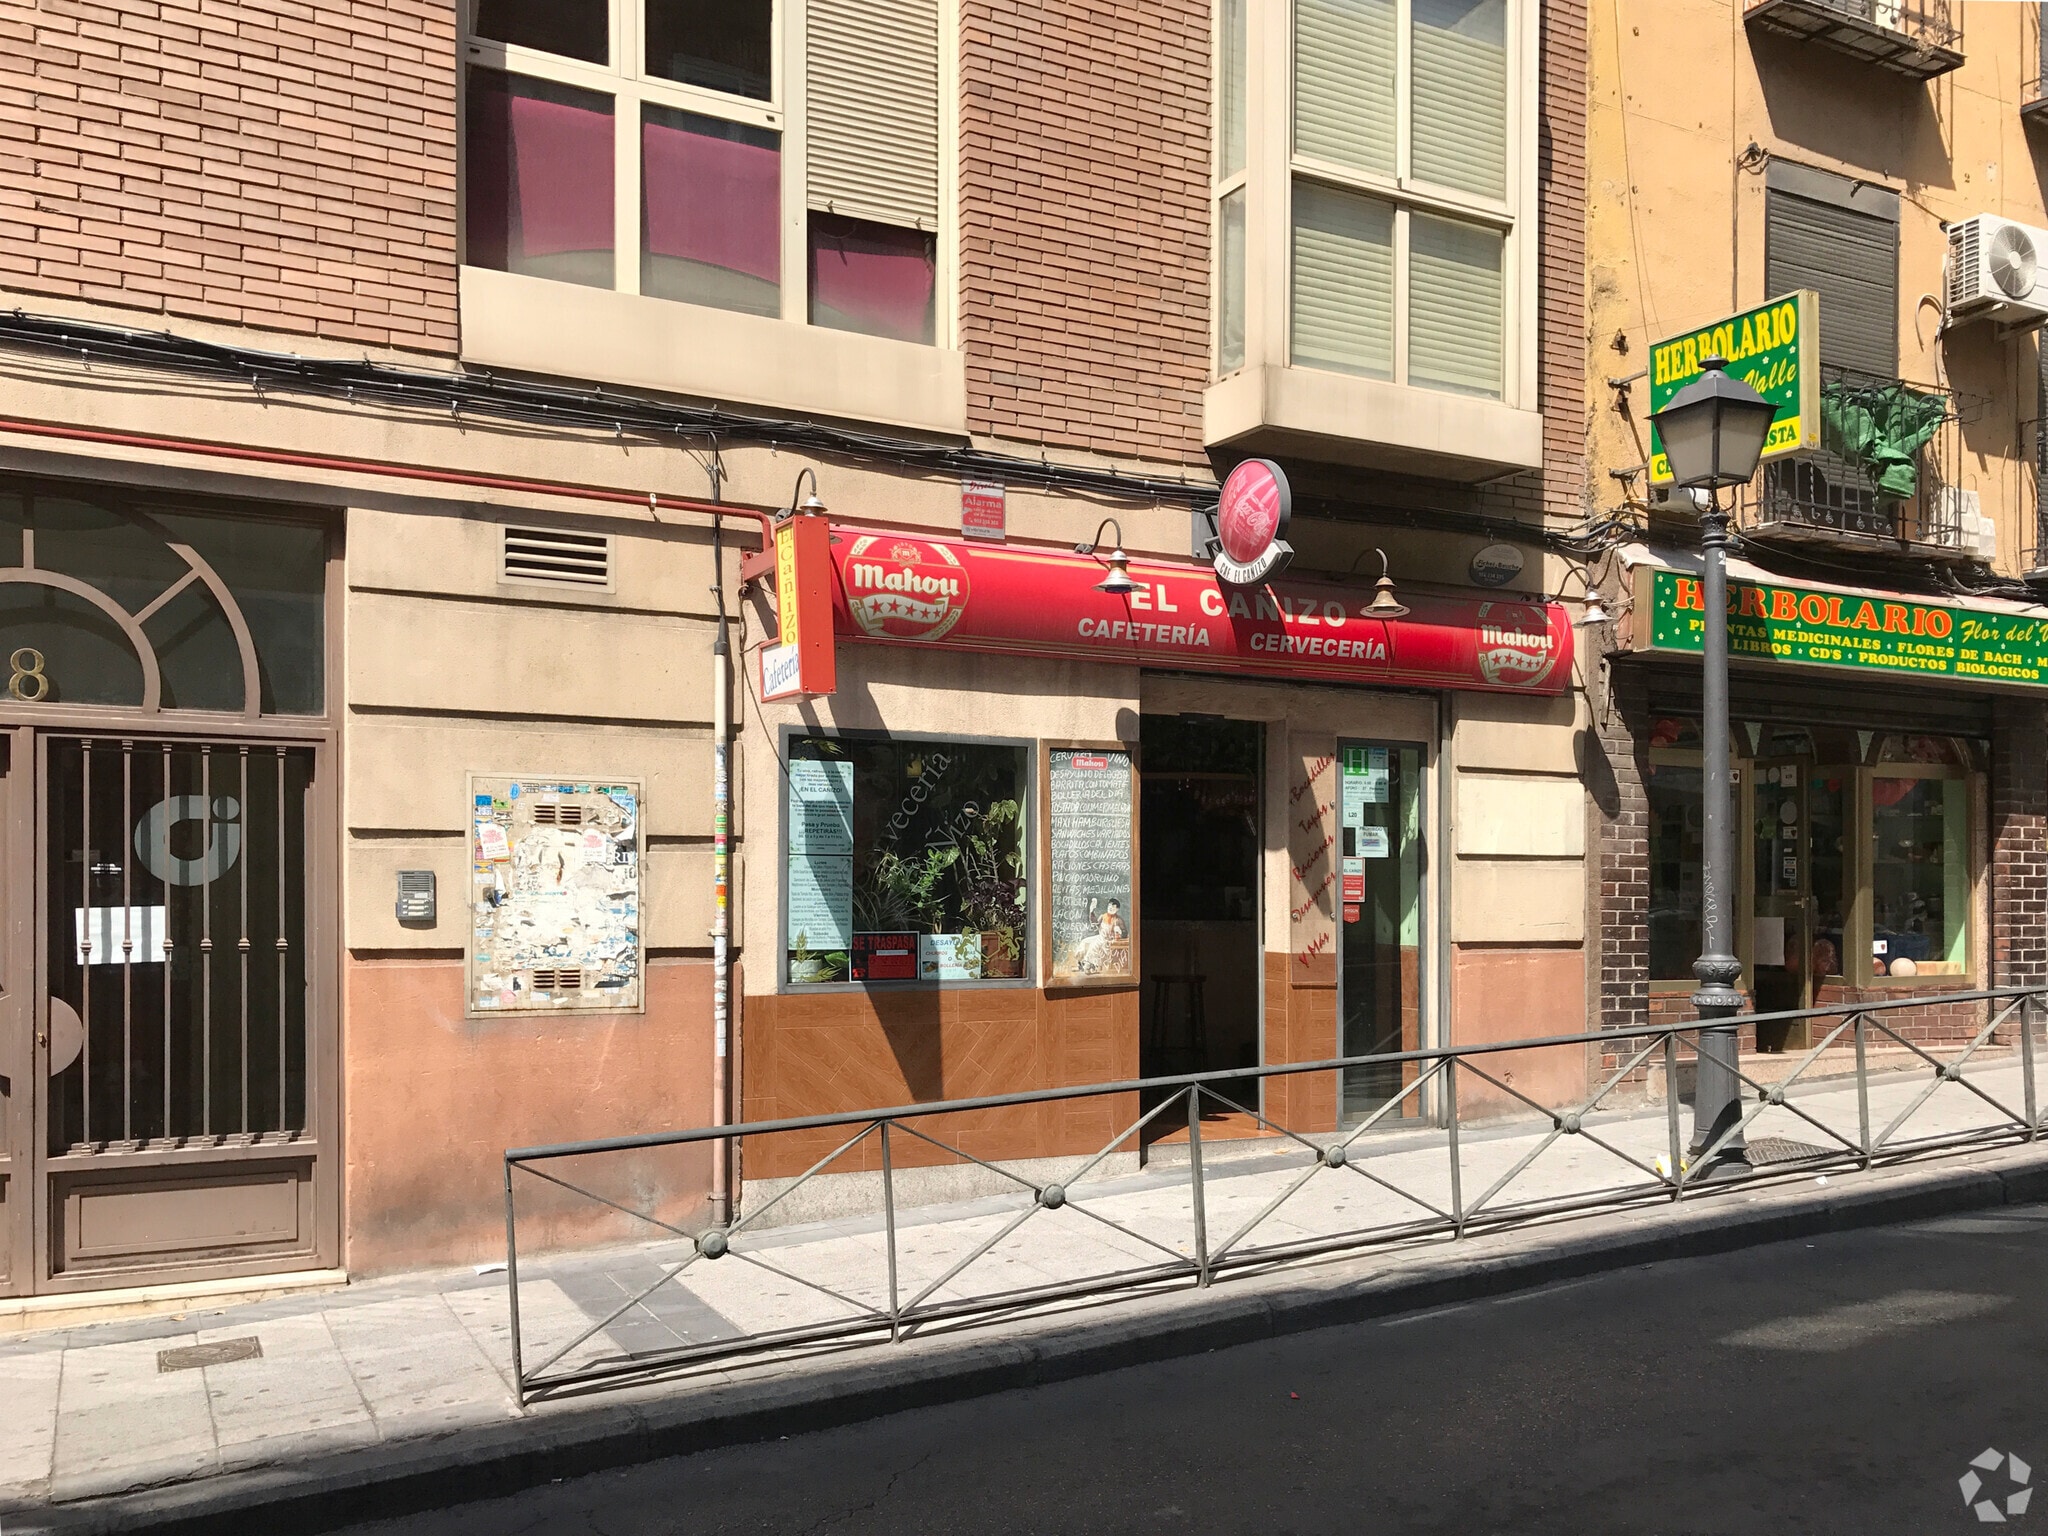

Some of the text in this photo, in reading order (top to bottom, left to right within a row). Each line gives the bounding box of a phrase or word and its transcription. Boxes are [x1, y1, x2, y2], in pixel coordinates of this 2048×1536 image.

[1655, 303, 1796, 386] HERBOLARIO
[1743, 357, 1797, 394] Valle
[853, 563, 960, 597] Mahou
[1131, 583, 1347, 628] EL CAÑIZO
[1078, 617, 1386, 661] CAFETERÍA CERVECERÍA
[1481, 624, 1554, 650] Mahou
[1773, 628, 1881, 650] MEDICINALES
[1897, 642, 1955, 658] FLORES
[1960, 648, 1979, 661] DE
[1984, 651, 2022, 665] BACH
[1961, 620, 2000, 643] Flor
[2005, 625, 2034, 641] del
[9, 647, 49, 701] 8
[1733, 638, 2040, 680] LIBROS CD'S PRODUCTOS BIOLOGICOS
[1075, 759, 1104, 767] Mahou
[1107, 753, 1130, 767] VINO
[1345, 749, 1367, 774] H
[1298, 804, 1328, 834] Tapas
[1292, 834, 1334, 883] Raciones
[853, 936, 865, 950] SE
[868, 935, 916, 950] TRASPASA
